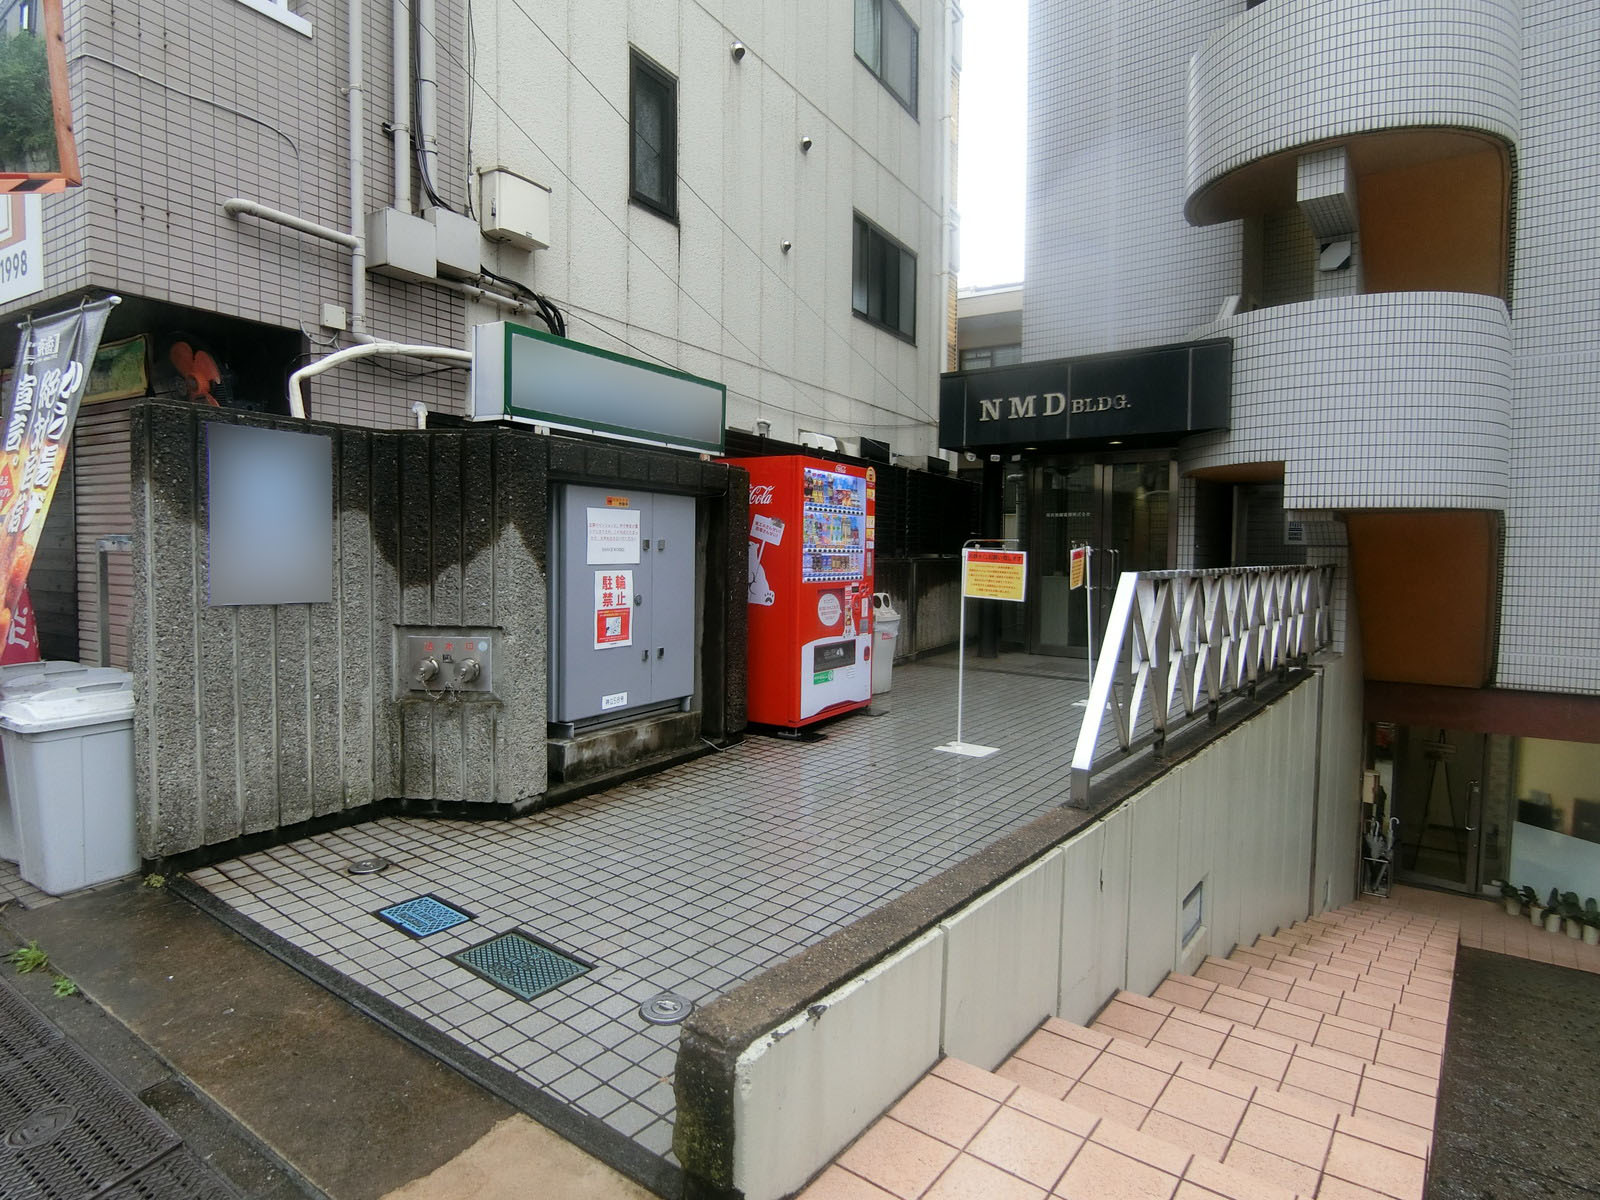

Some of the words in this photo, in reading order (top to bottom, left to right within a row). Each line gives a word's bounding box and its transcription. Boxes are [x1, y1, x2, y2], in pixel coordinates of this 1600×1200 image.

[0, 250, 28, 283] 1998
[1071, 394, 1131, 414] BLDG.
[21, 360, 84, 532] から揚げ
[602, 575, 626, 591] 駐輪
[602, 591, 627, 607] 禁止
